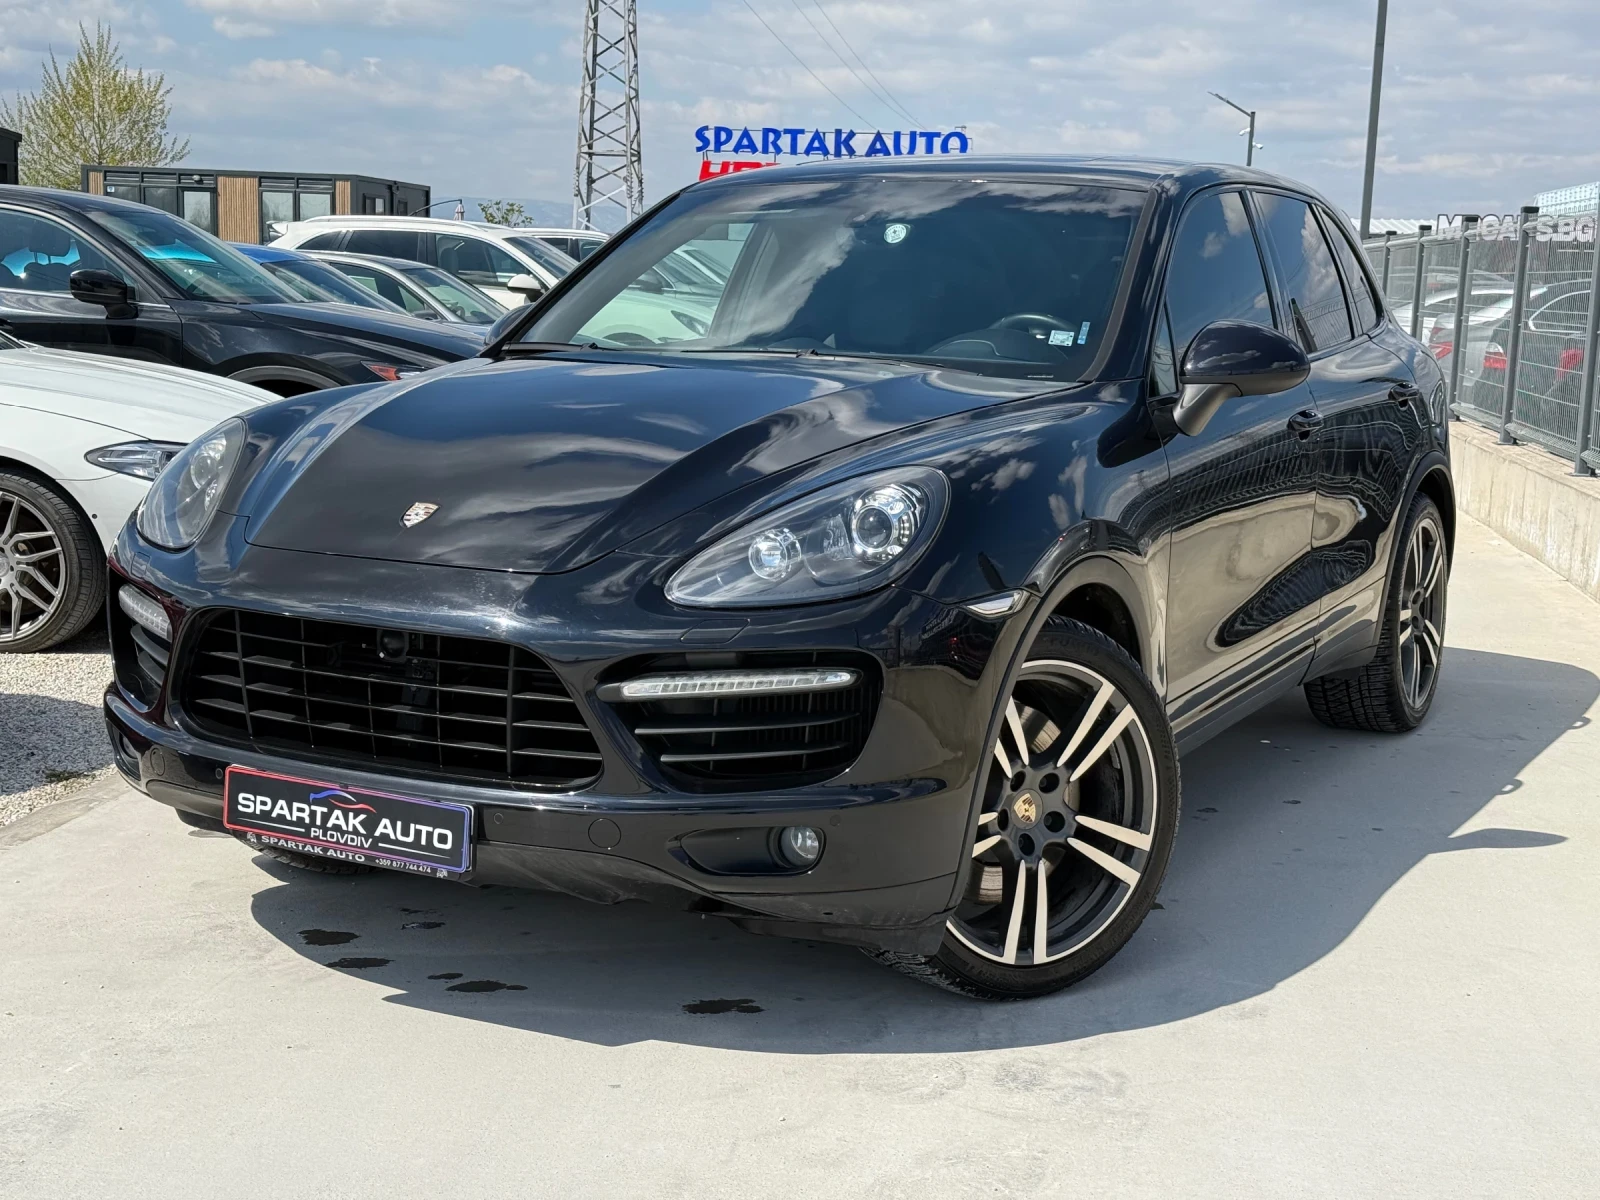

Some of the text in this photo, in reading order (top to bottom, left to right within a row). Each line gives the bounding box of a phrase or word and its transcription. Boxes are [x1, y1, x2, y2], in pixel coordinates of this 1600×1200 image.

[695, 125, 969, 159] SPARTAK AUTO
[237, 792, 452, 850] SPARTAK AUTO
[261, 836, 365, 861] SPARTAK AUTO
[311, 828, 372, 848] PLOVDIV
[375, 858, 391, 867] +359
[392, 861, 404, 869] 877
